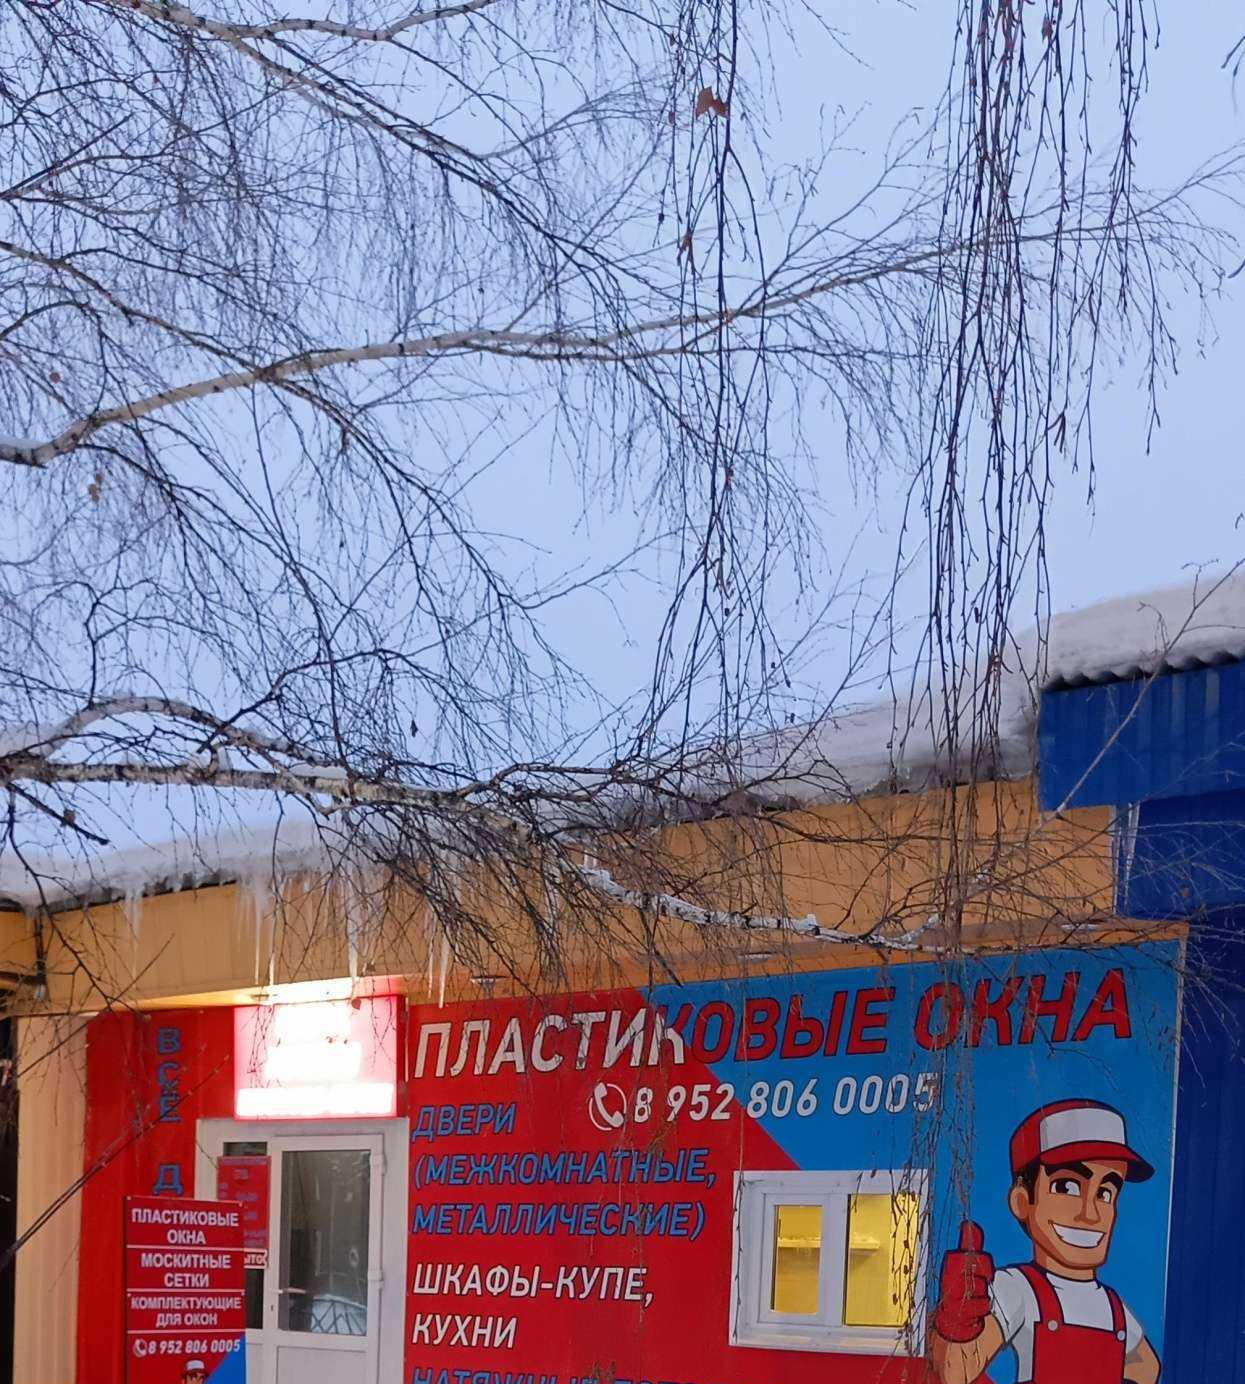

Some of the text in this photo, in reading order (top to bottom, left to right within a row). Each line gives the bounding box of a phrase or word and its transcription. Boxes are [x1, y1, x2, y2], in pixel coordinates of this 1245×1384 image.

[413, 986, 896, 1078] ПЛАСТИКОВЫЕ
[914, 967, 1132, 1050] ОКНА
[157, 1027, 182, 1122] ВСЕ
[633, 1071, 940, 1123] 8 952 806 0005
[411, 1102, 517, 1142] ДВЕРИ
[413, 1147, 717, 1189] (МЕЖКОМНАТНЫЕ,
[131, 1208, 239, 1227] ПЛАСТИКОВЫЕ
[412, 1201, 706, 1240] МЕТАЛЛИЧЕСКИЕ)
[166, 1229, 206, 1245] ОКНА
[141, 1252, 231, 1269] МОСКИТНЫЕ
[163, 1273, 209, 1288] СЕТКИ
[412, 1262, 655, 1311] ШКАФЫ-КУПЕ,
[131, 1296, 242, 1311] КОМПЛЕКТУЮЩИЕ
[155, 1313, 218, 1328] ДЛЯ ОКОН
[148, 1339, 241, 1355] 8 952 806 0005
[411, 1312, 518, 1349] КУХНИ
